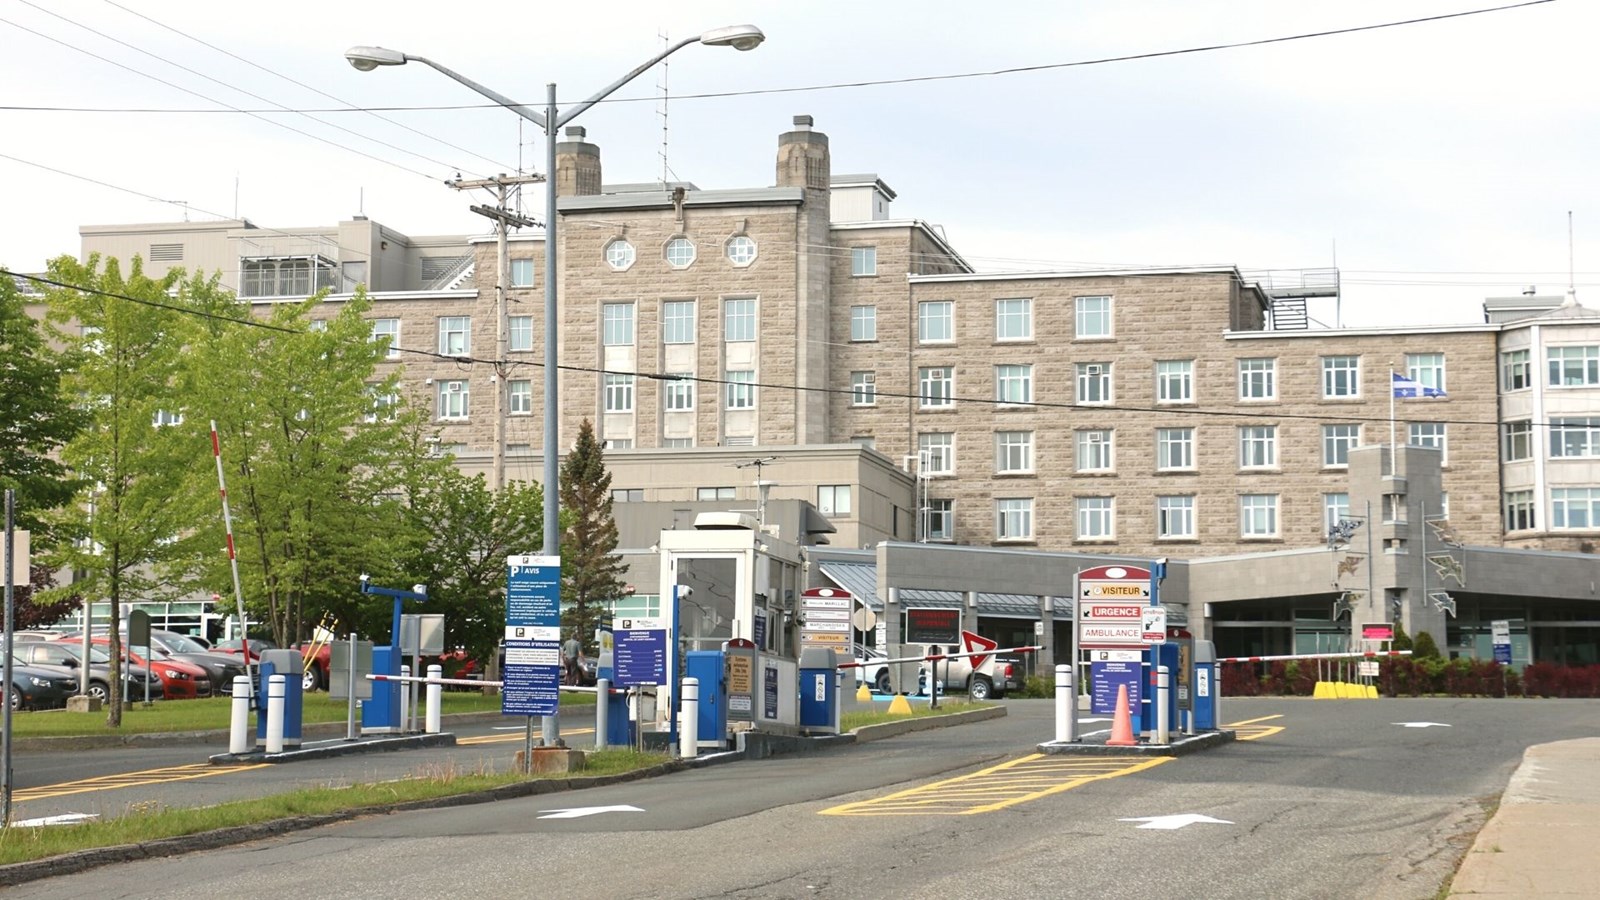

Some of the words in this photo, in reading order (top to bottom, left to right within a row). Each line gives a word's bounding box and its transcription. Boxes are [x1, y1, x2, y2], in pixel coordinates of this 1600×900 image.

[1102, 587, 1140, 595] VISITEUR
[1094, 608, 1139, 616] URGENCE
[1085, 629, 1139, 637] AMBULANCE
